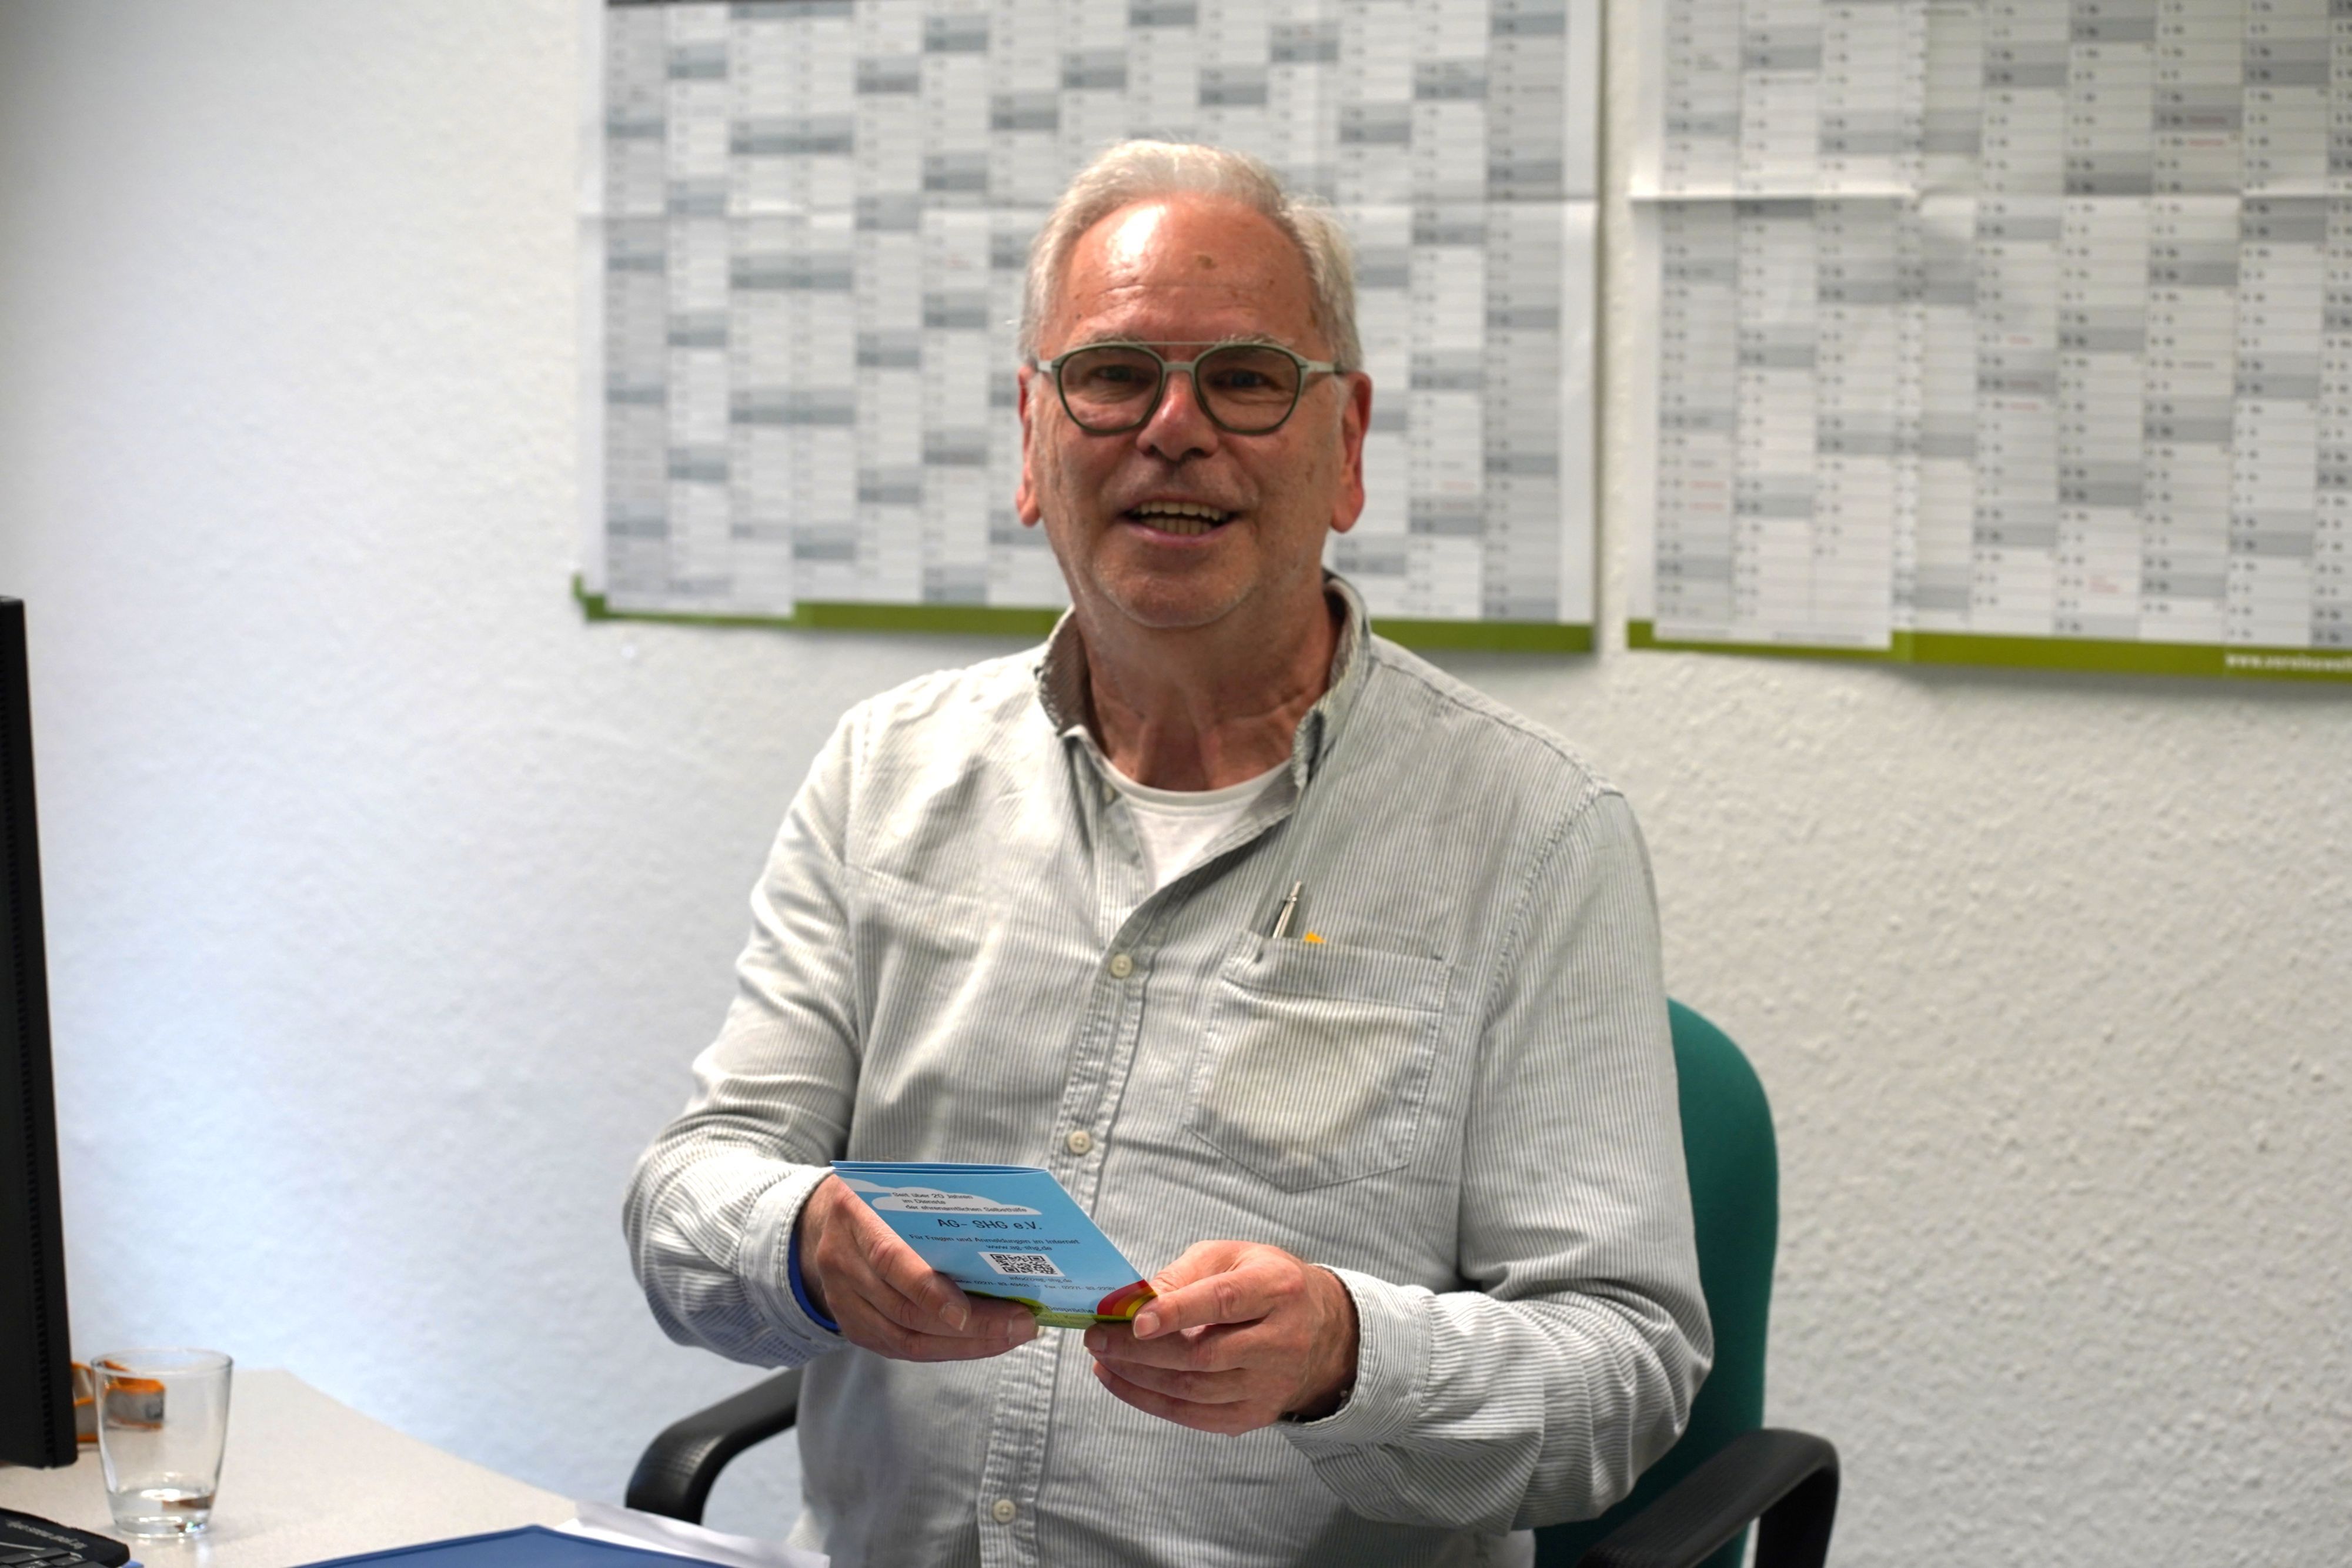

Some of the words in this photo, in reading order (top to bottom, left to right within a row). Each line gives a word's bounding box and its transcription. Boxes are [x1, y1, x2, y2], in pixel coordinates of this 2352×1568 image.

[937, 1219, 968, 1228] AG-
[972, 1220, 1008, 1229] SHG
[1013, 1221, 1043, 1230] e.V.
